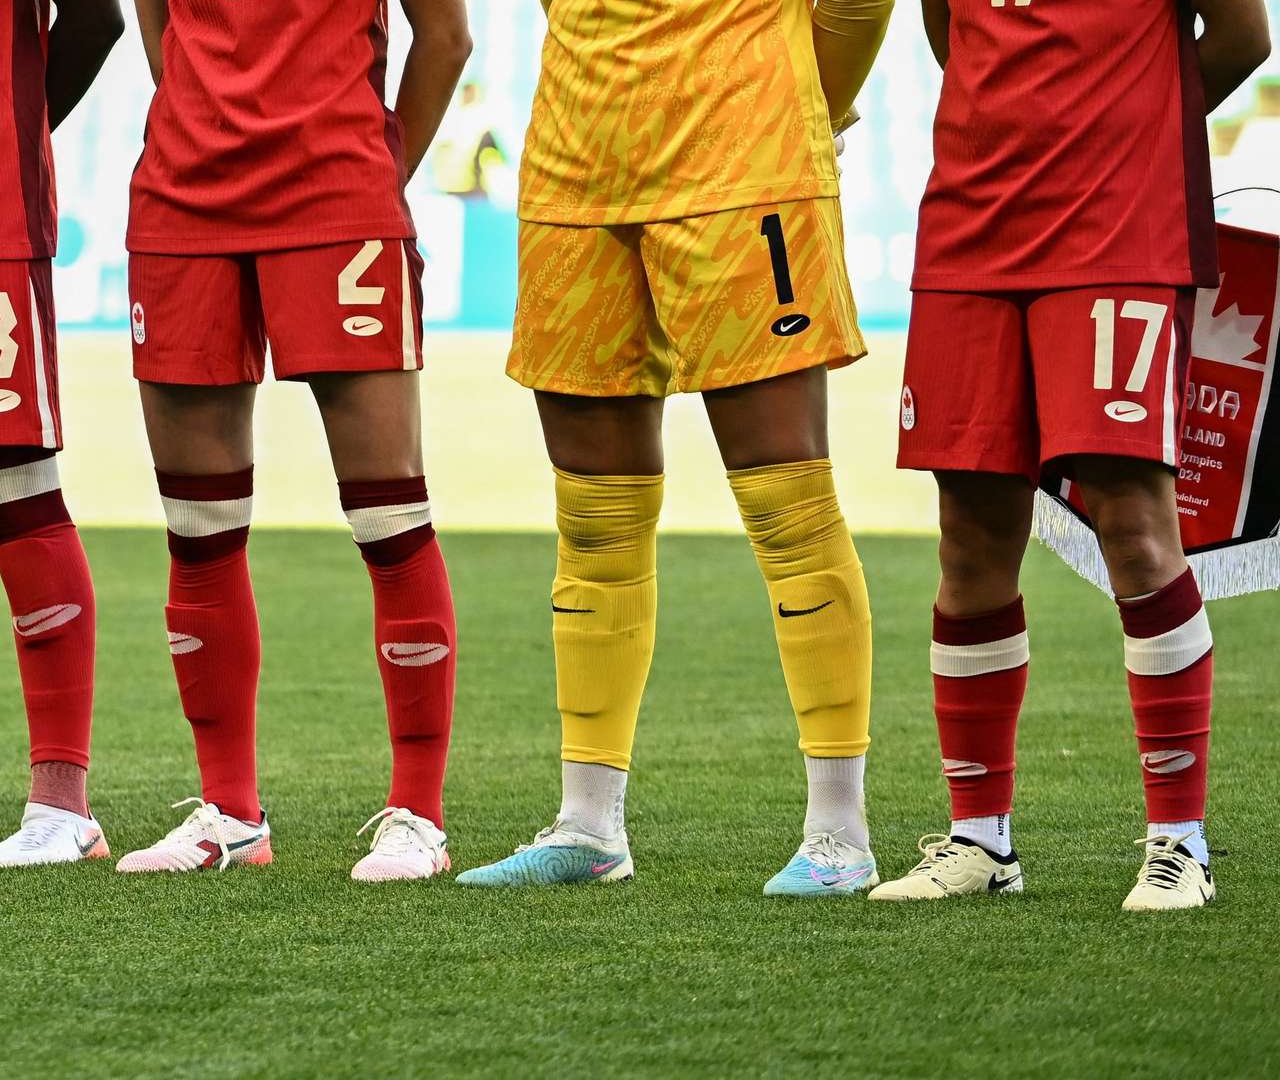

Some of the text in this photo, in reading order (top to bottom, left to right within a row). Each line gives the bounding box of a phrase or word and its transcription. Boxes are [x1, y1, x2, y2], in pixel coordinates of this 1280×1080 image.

[760, 213, 795, 305] 1
[1090, 298, 1168, 393] 17
[1183, 425, 1226, 448] LAND
[1180, 450, 1223, 470] lympics
[1178, 467, 1201, 483] 024
